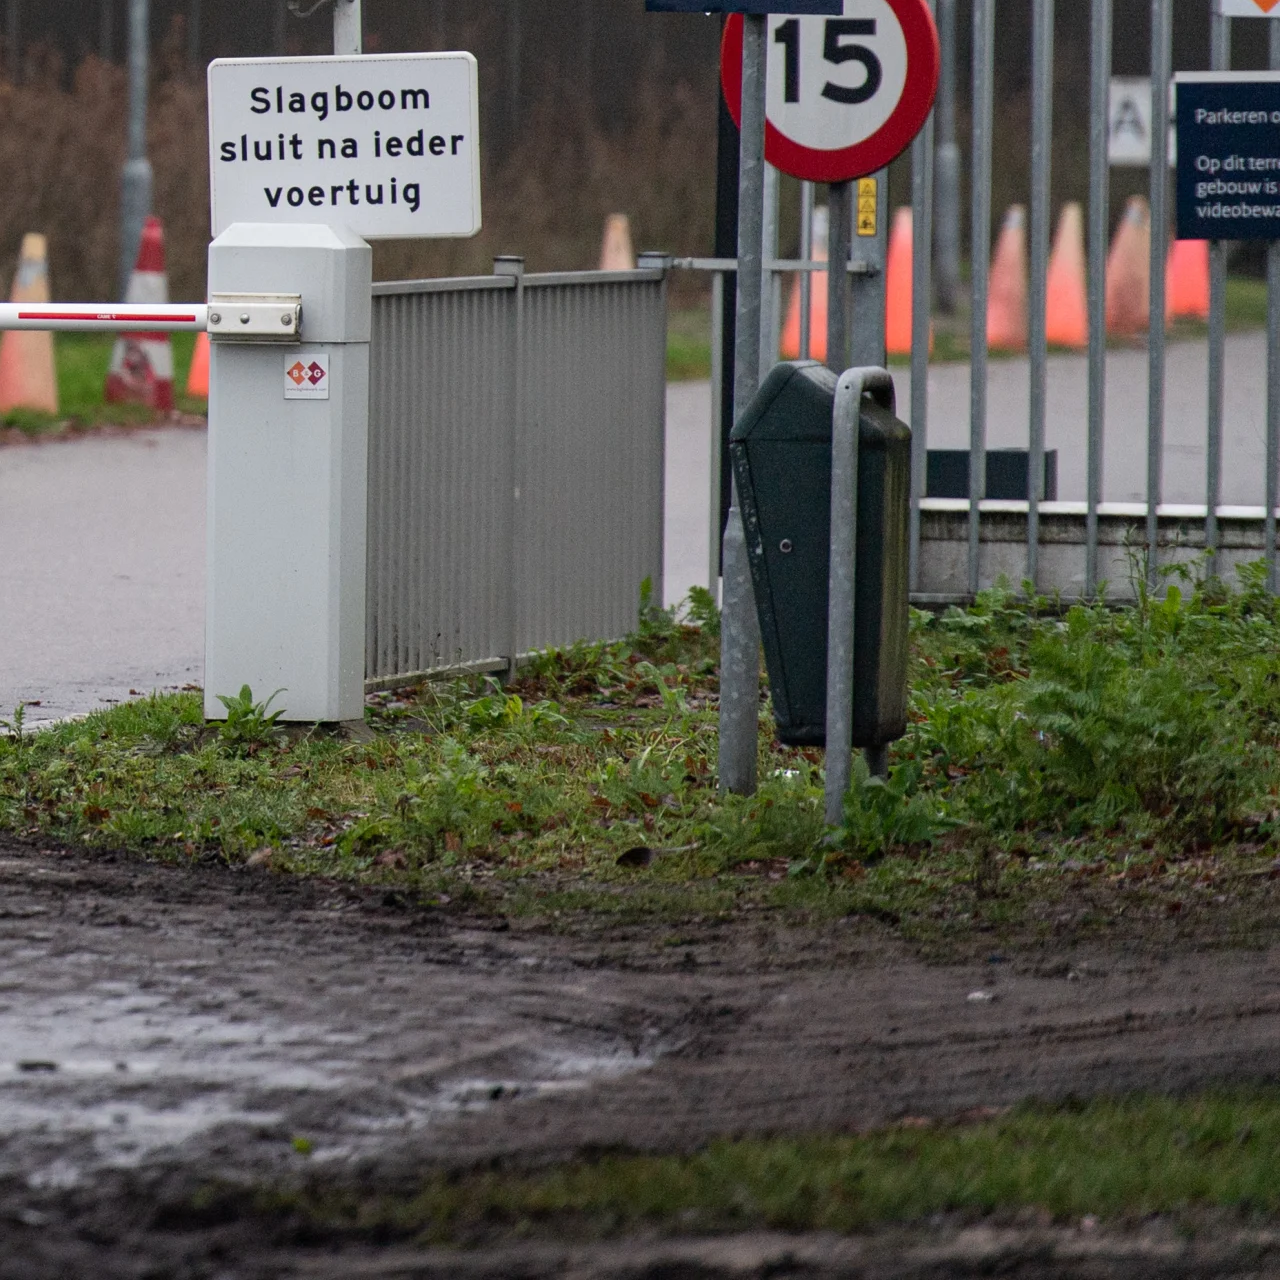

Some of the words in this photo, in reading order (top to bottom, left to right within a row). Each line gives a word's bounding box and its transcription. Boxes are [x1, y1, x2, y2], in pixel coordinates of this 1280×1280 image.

[774, 18, 883, 104] 15
[250, 84, 430, 121] Slagboom
[1195, 108, 1268, 124] Parkeren
[220, 133, 303, 161] sluit
[317, 137, 358, 159] na
[374, 129, 464, 157] ieder
[1196, 155, 1220, 174] Op
[1223, 154, 1245, 171] dit
[264, 177, 421, 213] voertuig
[1196, 178, 1262, 198] gebouw
[1264, 178, 1278, 194] is
